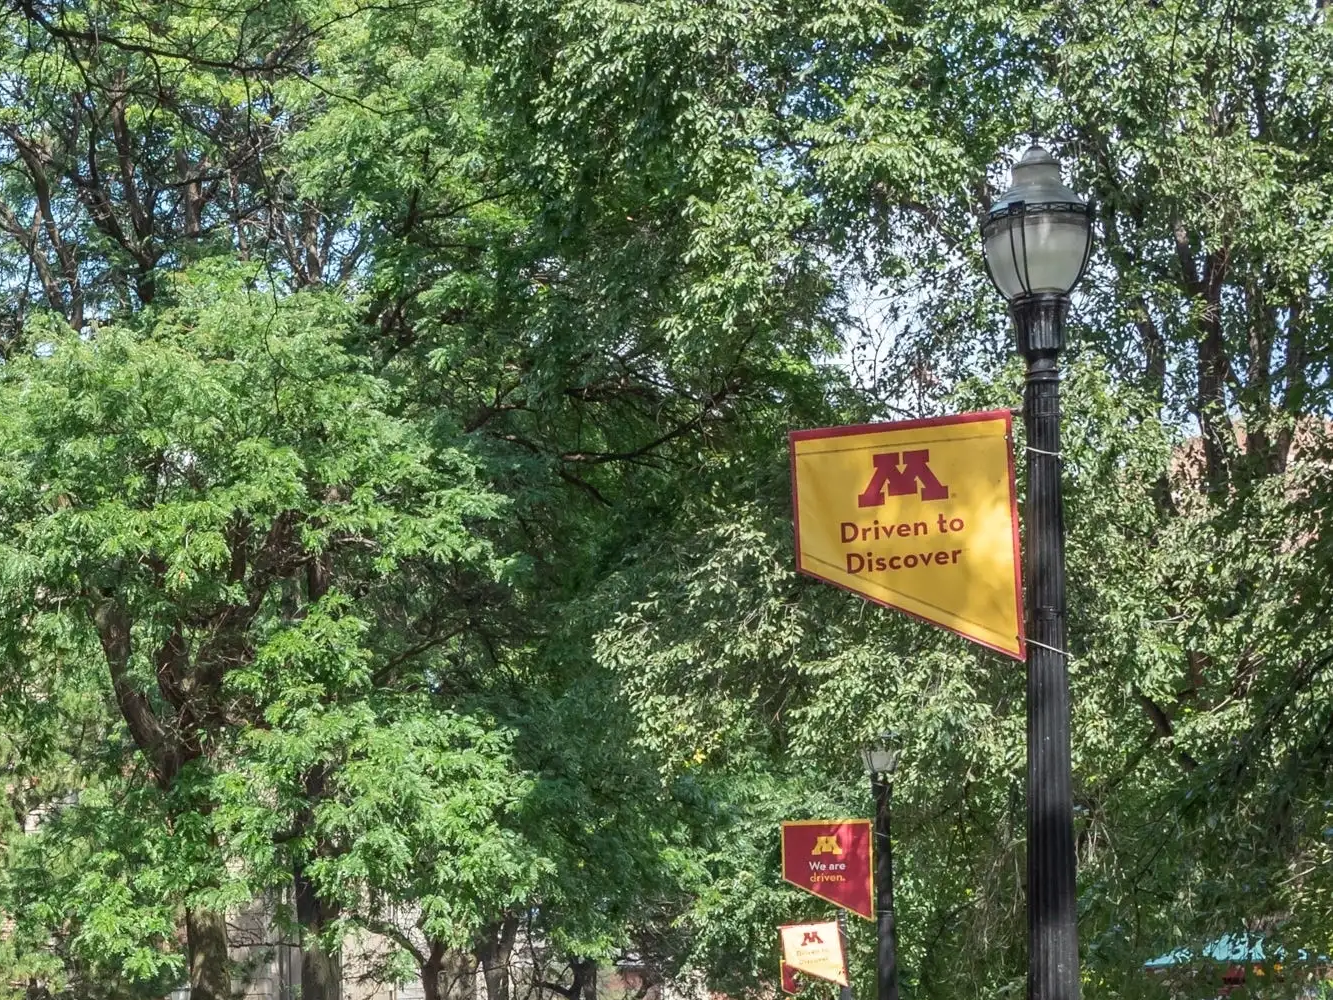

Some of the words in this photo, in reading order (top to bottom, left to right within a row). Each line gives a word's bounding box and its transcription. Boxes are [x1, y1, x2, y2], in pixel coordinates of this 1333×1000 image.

[840, 520, 928, 544] Driven
[937, 513, 965, 534] to
[846, 549, 962, 575] Discover
[809, 861, 826, 870] We
[809, 872, 846, 882] driven.
